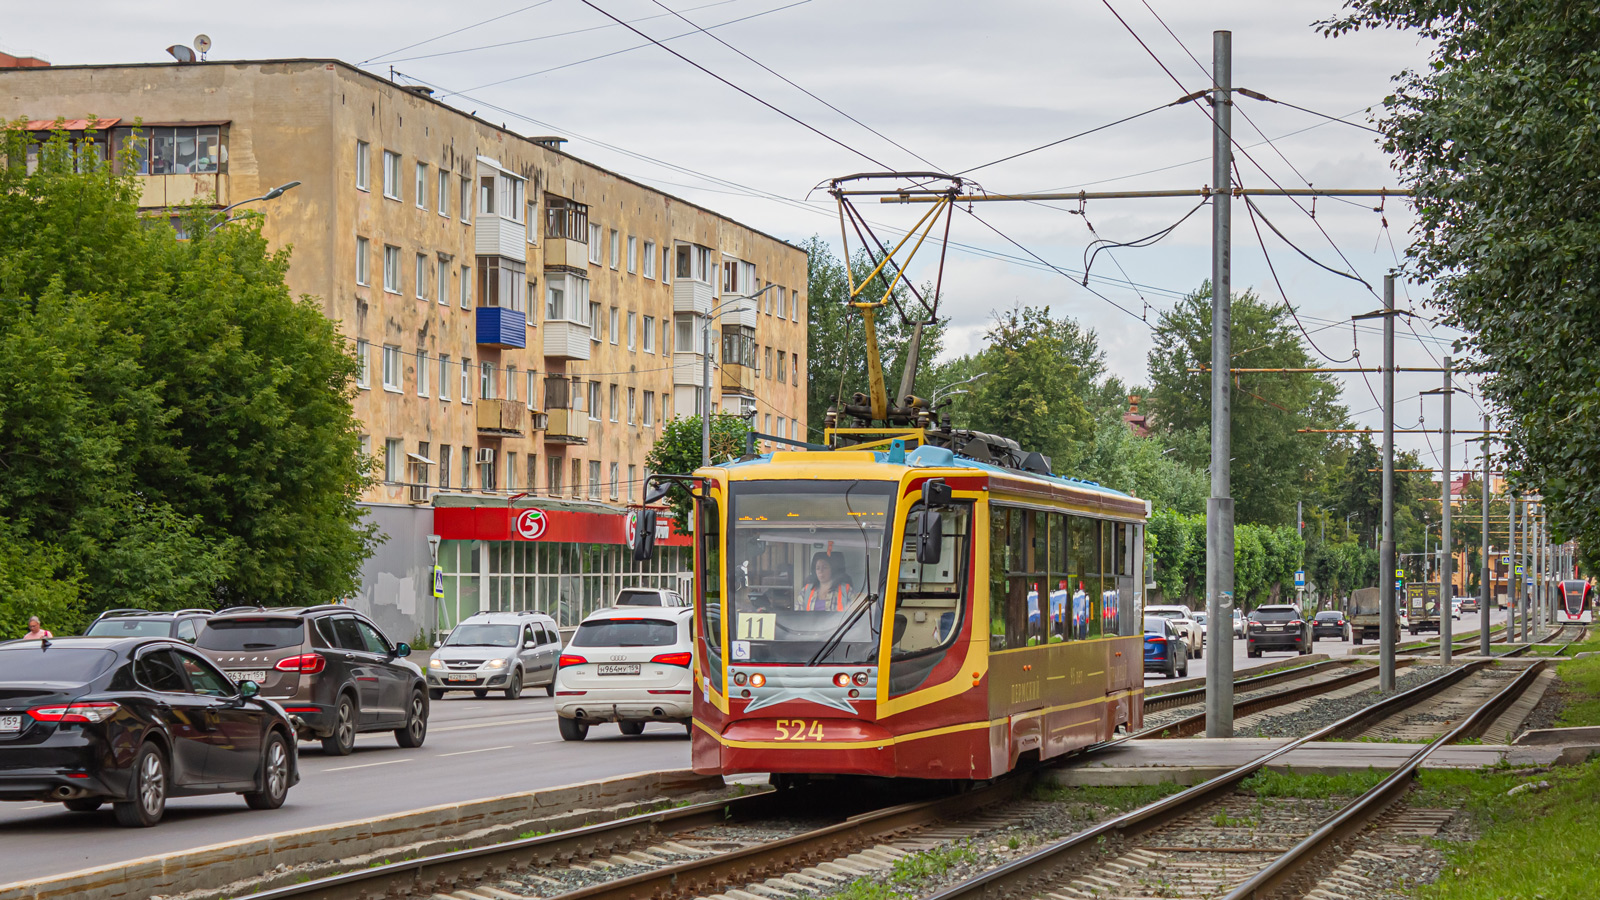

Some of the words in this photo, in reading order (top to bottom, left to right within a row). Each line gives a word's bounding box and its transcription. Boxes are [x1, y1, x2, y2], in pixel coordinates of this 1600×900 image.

[523, 517, 539, 536] 5
[745, 617, 764, 639] 11
[1, 716, 18, 726] 159
[774, 719, 825, 741] 524
